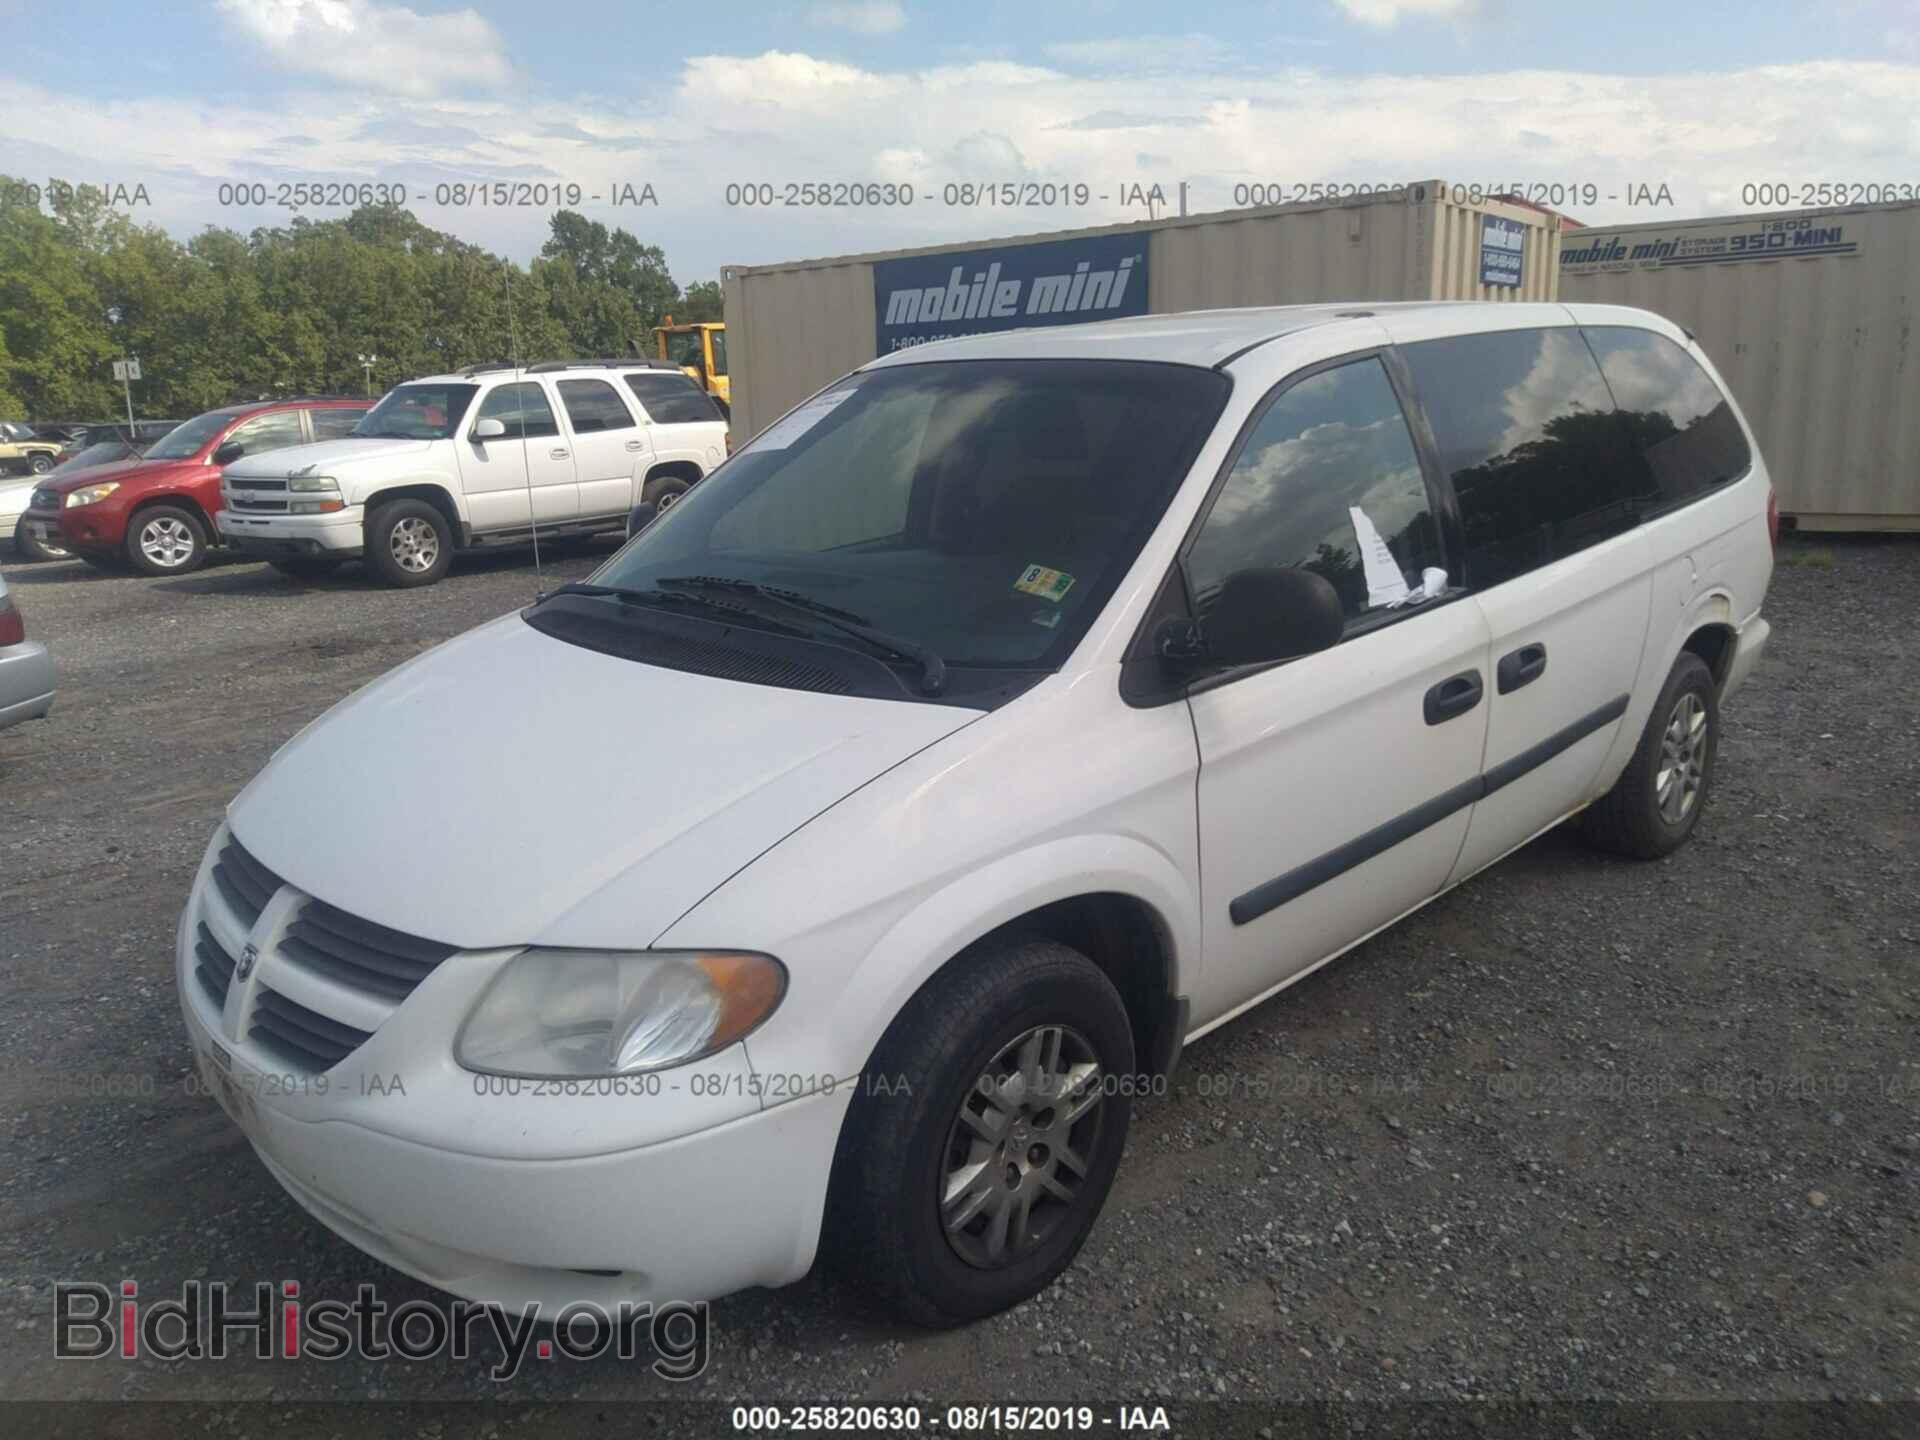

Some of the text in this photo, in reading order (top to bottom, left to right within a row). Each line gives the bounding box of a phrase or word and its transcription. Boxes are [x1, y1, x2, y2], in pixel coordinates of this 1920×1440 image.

[1558, 236, 1680, 264] mobile mini
[884, 256, 1134, 325] mobile mini
